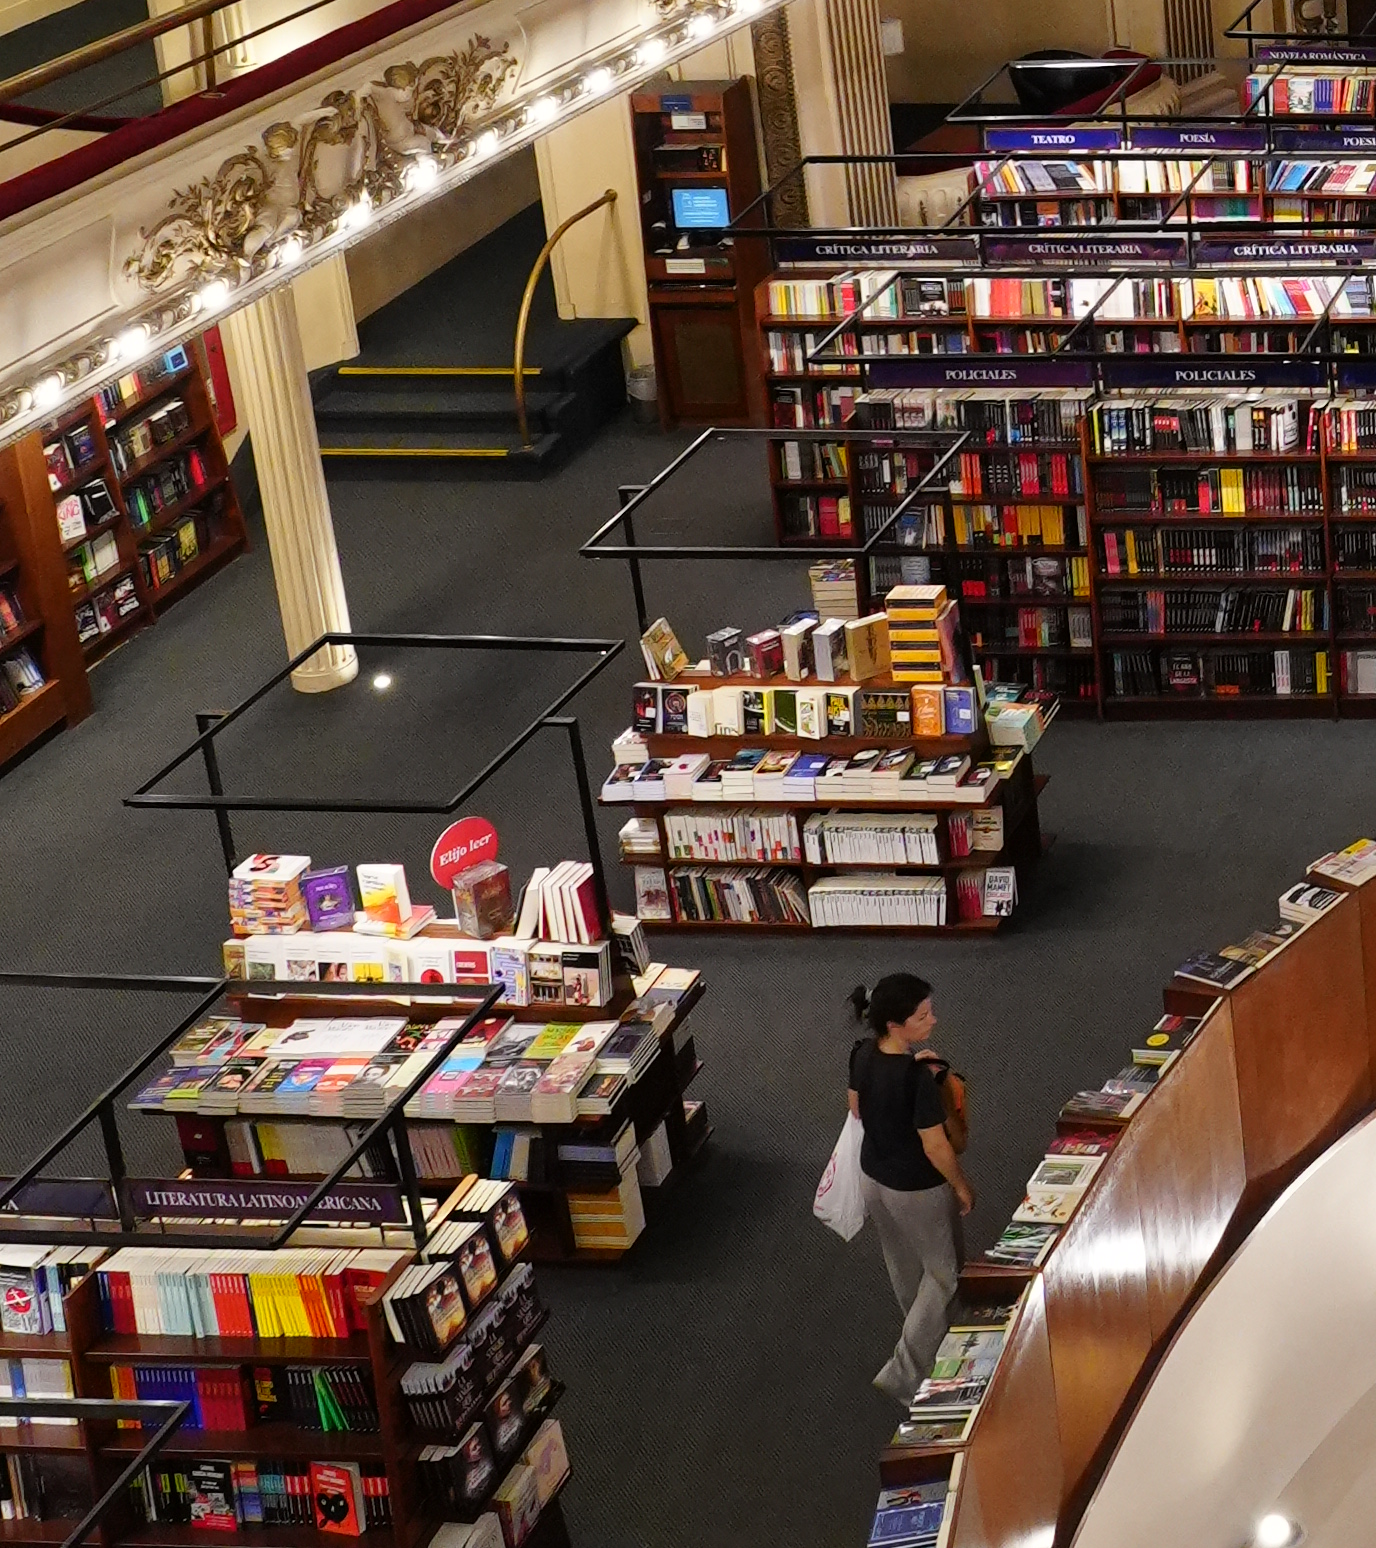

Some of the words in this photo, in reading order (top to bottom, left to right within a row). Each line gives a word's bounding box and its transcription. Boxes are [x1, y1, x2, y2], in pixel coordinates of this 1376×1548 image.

[1031, 134, 1076, 144] TEATRO
[1179, 131, 1216, 144] POESÍA
[816, 242, 868, 255] CRÍTICA
[871, 245, 938, 255] LITERARIA
[1028, 242, 1078, 254] CRÍTICA
[1081, 244, 1142, 254] LITERARIA
[1234, 242, 1287, 255] CRÍTICA
[1290, 243, 1358, 255] LITERARIA
[945, 369, 1017, 381] POLICIALES
[1175, 369, 1256, 381] POLICIALES
[438, 841, 468, 868] Elijo
[468, 831, 492, 854] leer
[145, 1190, 239, 1211] LITERATURA
